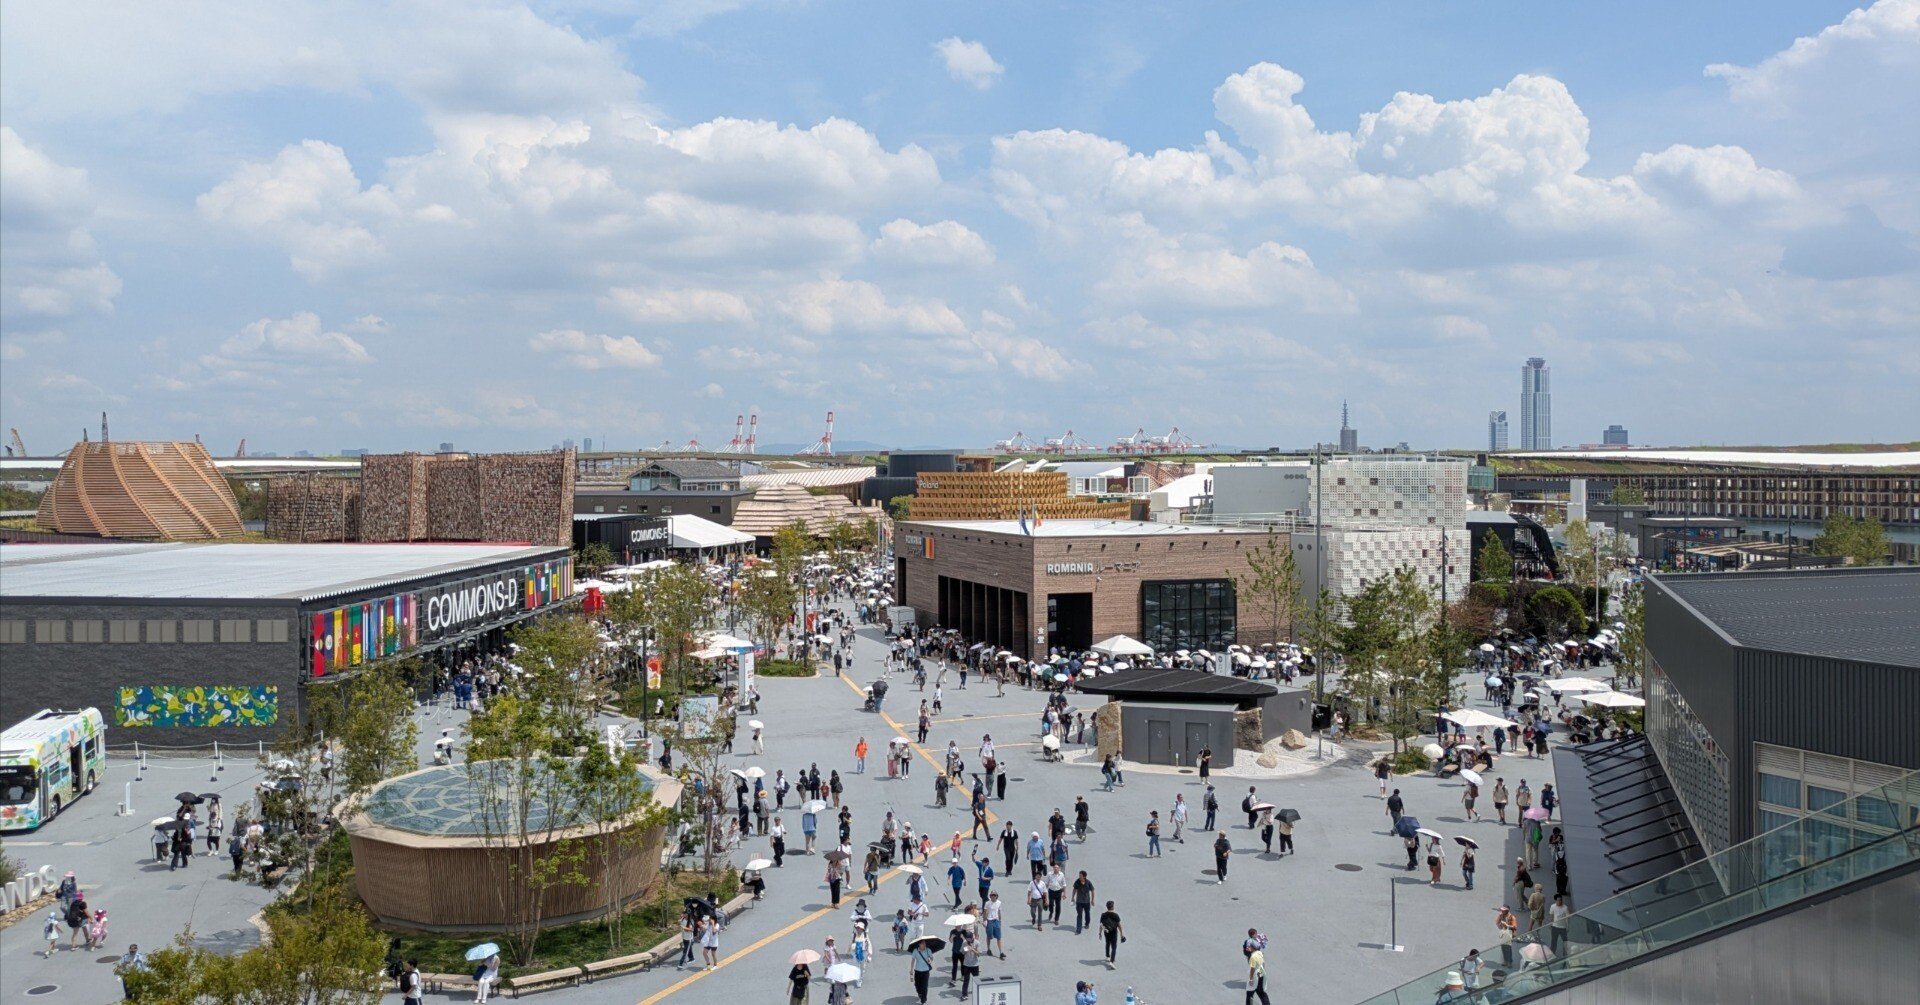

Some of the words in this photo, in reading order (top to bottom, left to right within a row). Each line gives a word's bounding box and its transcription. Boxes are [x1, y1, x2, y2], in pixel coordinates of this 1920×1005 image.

[920, 480, 939, 489] Poland
[631, 527, 668, 543] COMMONS-E
[1046, 562, 1094, 575] ROMANIA
[428, 578, 517, 631] COMMONS-D
